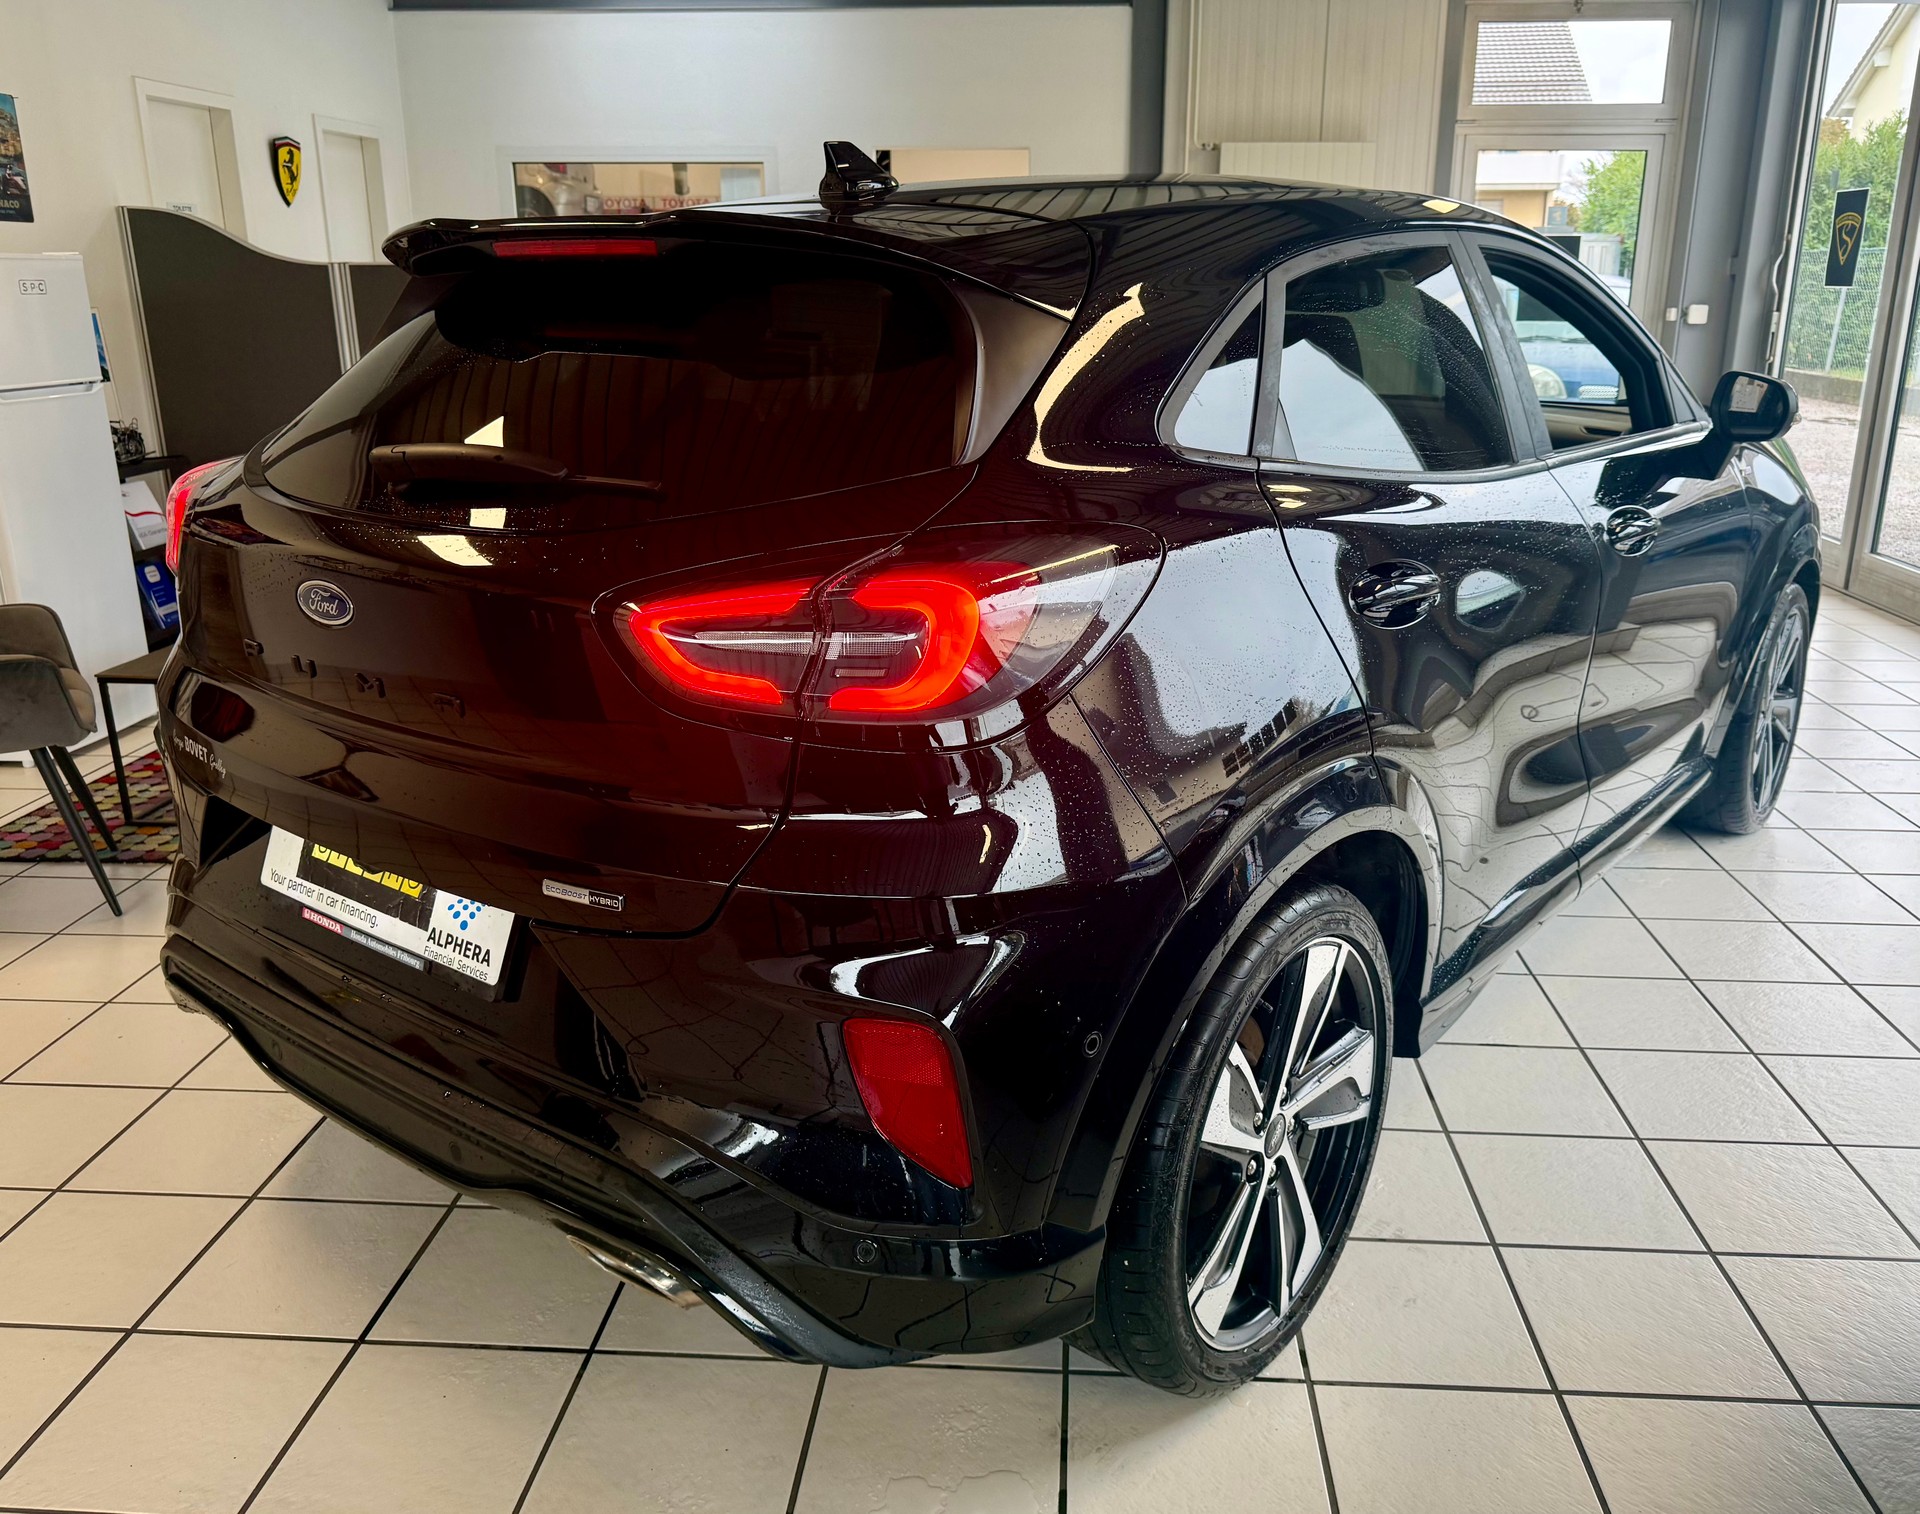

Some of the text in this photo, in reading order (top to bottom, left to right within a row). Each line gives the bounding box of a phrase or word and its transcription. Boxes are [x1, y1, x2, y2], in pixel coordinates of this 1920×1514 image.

[0, 199, 20, 209] NACO
[604, 198, 647, 208] OYOTA
[309, 588, 339, 616] Ford
[243, 638, 466, 719] PUMA
[184, 736, 208, 764] BOVET
[270, 868, 379, 929] Your partner in car financing.
[589, 895, 619, 907] HYBRID
[309, 911, 342, 934] HONDA
[426, 927, 491, 967] ALPHERA
[423, 945, 489, 981] Financial Services
